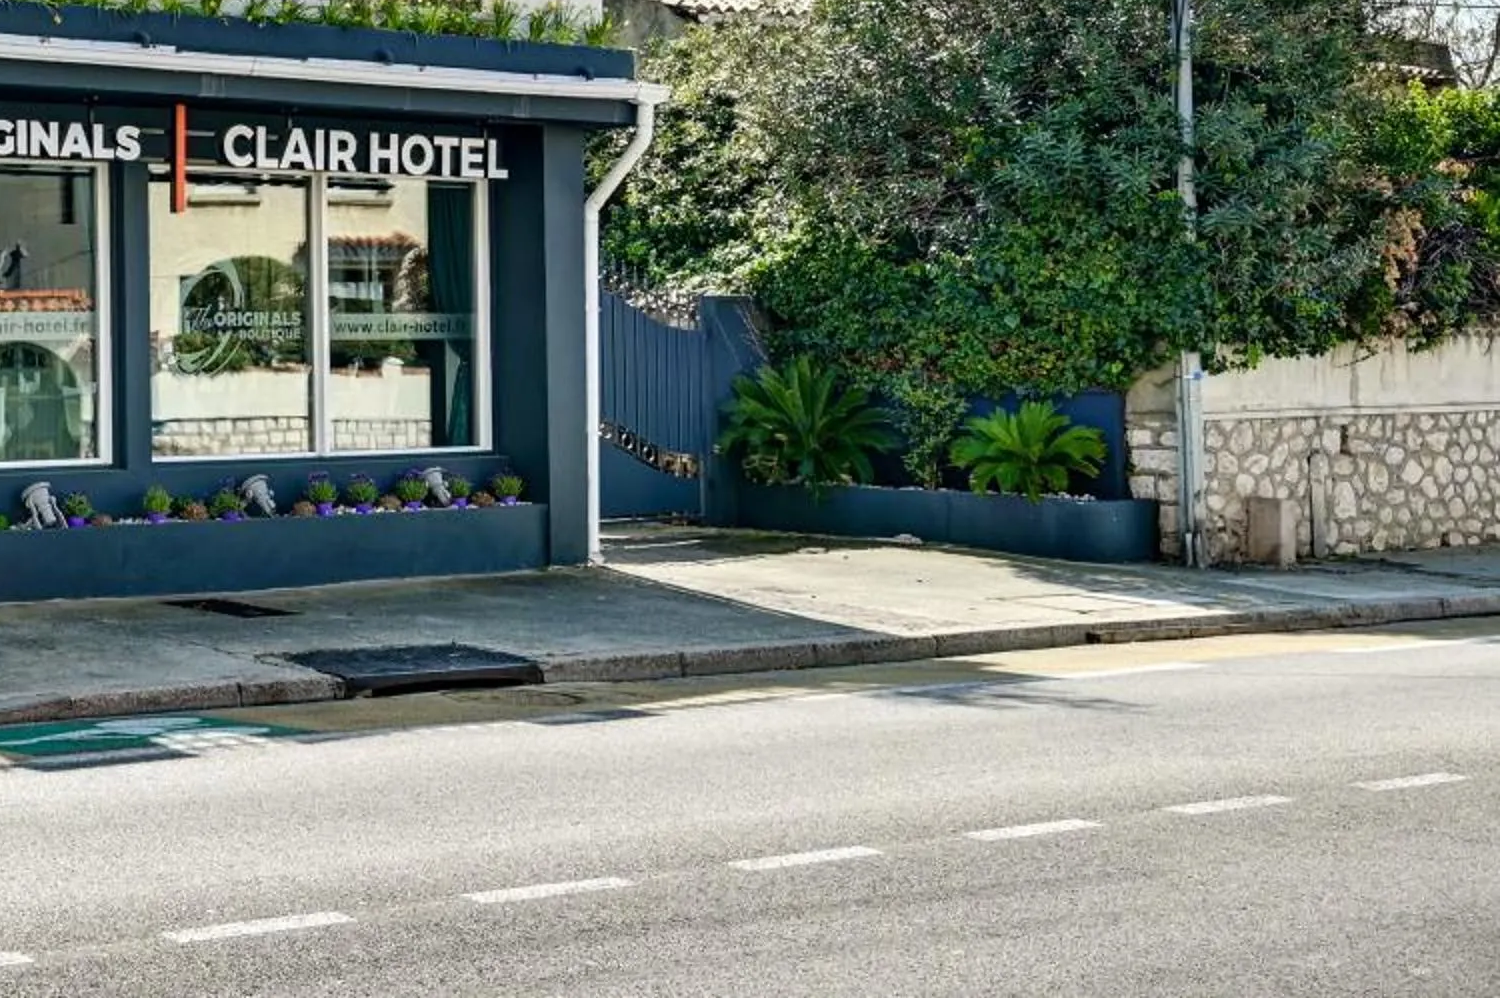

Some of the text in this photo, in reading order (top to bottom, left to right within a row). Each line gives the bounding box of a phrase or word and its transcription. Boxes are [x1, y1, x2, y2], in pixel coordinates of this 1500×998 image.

[223, 124, 358, 172] CLAIR
[369, 131, 509, 179] HOTEL
[213, 311, 302, 328] ORIGINALS
[239, 328, 301, 339] BOUTIQUE
